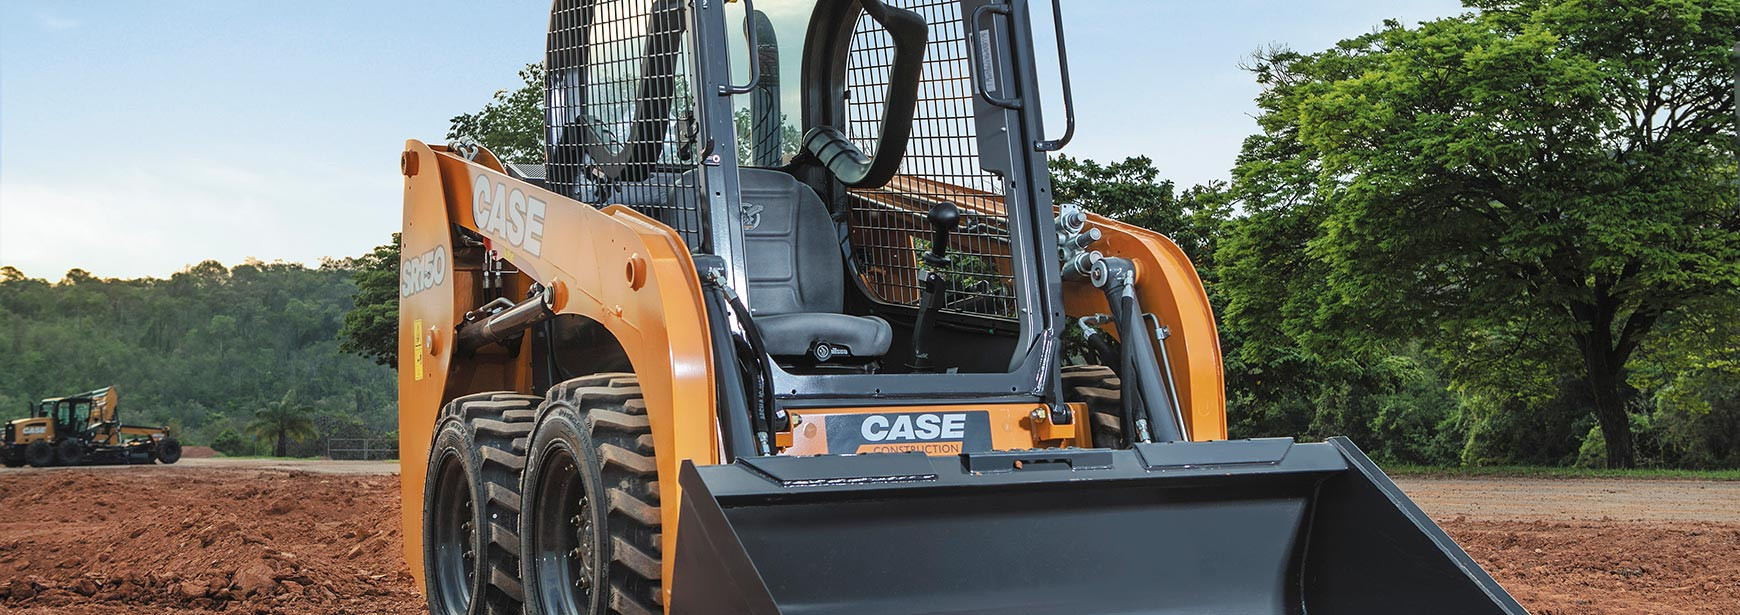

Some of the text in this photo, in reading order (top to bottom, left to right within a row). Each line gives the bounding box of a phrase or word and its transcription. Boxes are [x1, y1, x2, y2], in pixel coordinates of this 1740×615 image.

[473, 174, 547, 258] CASE
[402, 245, 446, 298] SR150
[861, 413, 966, 441] CASE
[873, 444, 959, 454] CONSTRUCTION
